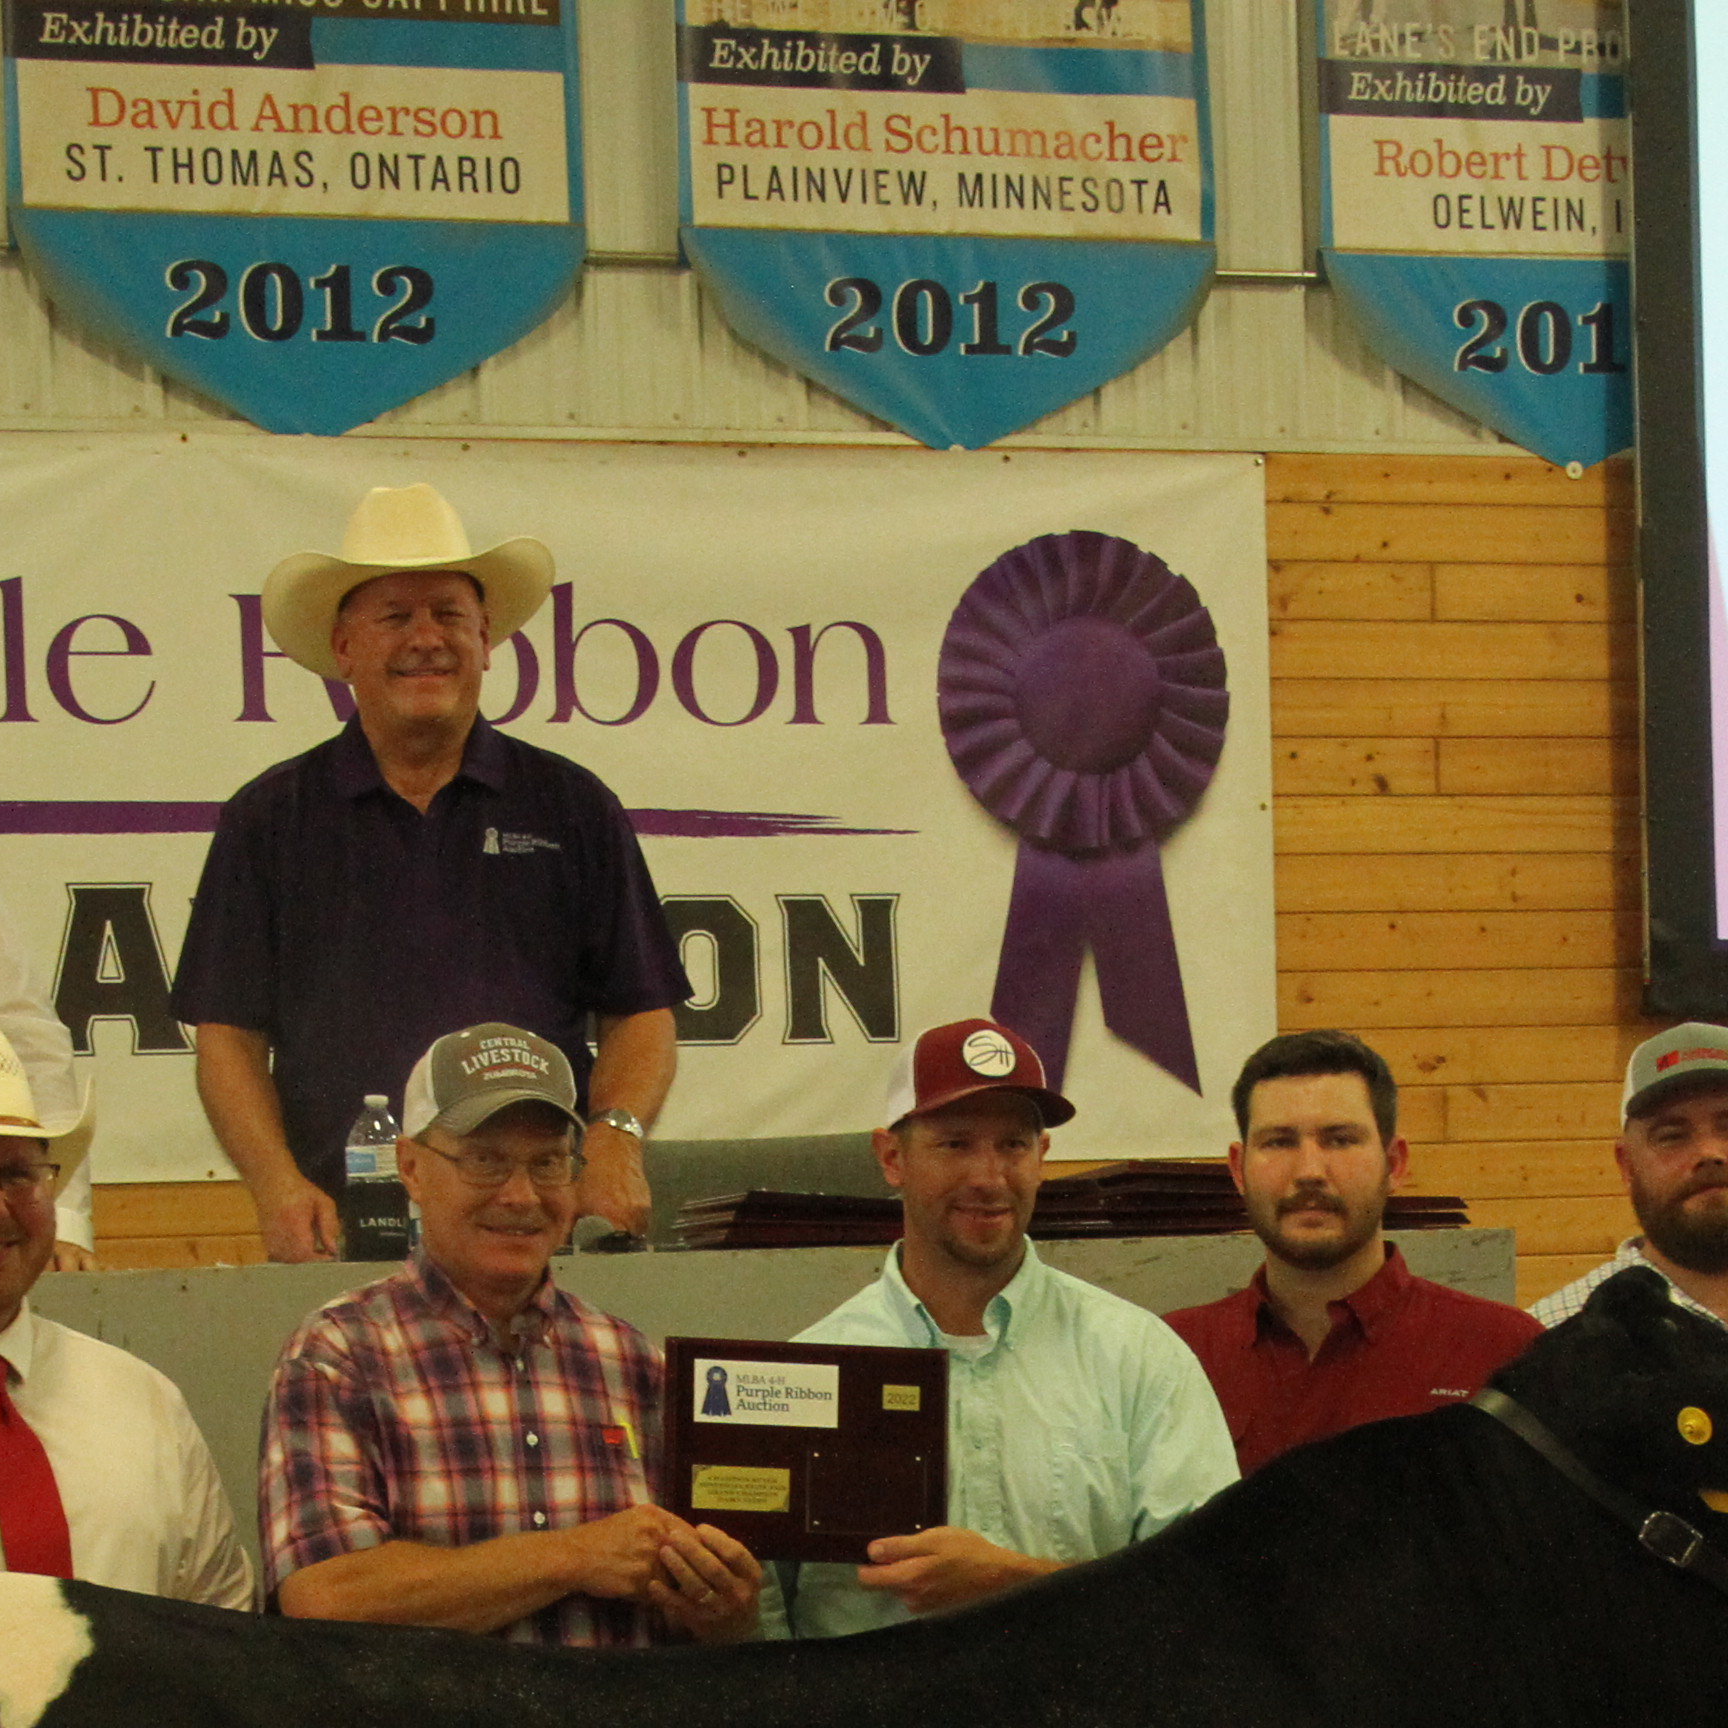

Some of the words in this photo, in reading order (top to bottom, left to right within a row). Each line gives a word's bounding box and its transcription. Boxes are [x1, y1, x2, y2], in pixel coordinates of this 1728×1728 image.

[38, 14, 226, 50] Exhibited
[234, 22, 280, 61] by
[1332, 21, 1456, 59] LANE'S
[1474, 27, 1540, 62] END
[709, 39, 882, 75] Exhibited
[890, 46, 931, 84] by
[86, 86, 236, 133] David
[252, 92, 505, 141] Anderson
[1348, 71, 1507, 106] Exhibited
[1514, 75, 1551, 114] by
[701, 107, 872, 152] Harold
[883, 113, 1188, 164] Schumacher
[64, 142, 125, 184] ST.
[144, 146, 330, 193] THOMAS,
[349, 152, 523, 195] ONTARIO
[1373, 139, 1526, 181] Robert
[716, 161, 938, 210] PLAINVIEW,
[957, 171, 1173, 215] MINNESOTA
[1432, 194, 1597, 236] OELWEIN,
[164, 259, 437, 345] 2012
[824, 277, 1078, 359] 2012
[228, 581, 898, 727] Rbon
[461, 1048, 549, 1075] LIVESTOCK
[480, 1037, 531, 1050] CENTRAL
[736, 1374, 766, 1384] MLBA
[736, 1385, 781, 1400] Purple
[784, 1388, 832, 1400] Ribbon
[887, 1393, 916, 1405] 2022
[1430, 1388, 1469, 1397] ARIAT
[736, 1399, 790, 1412] Auction
